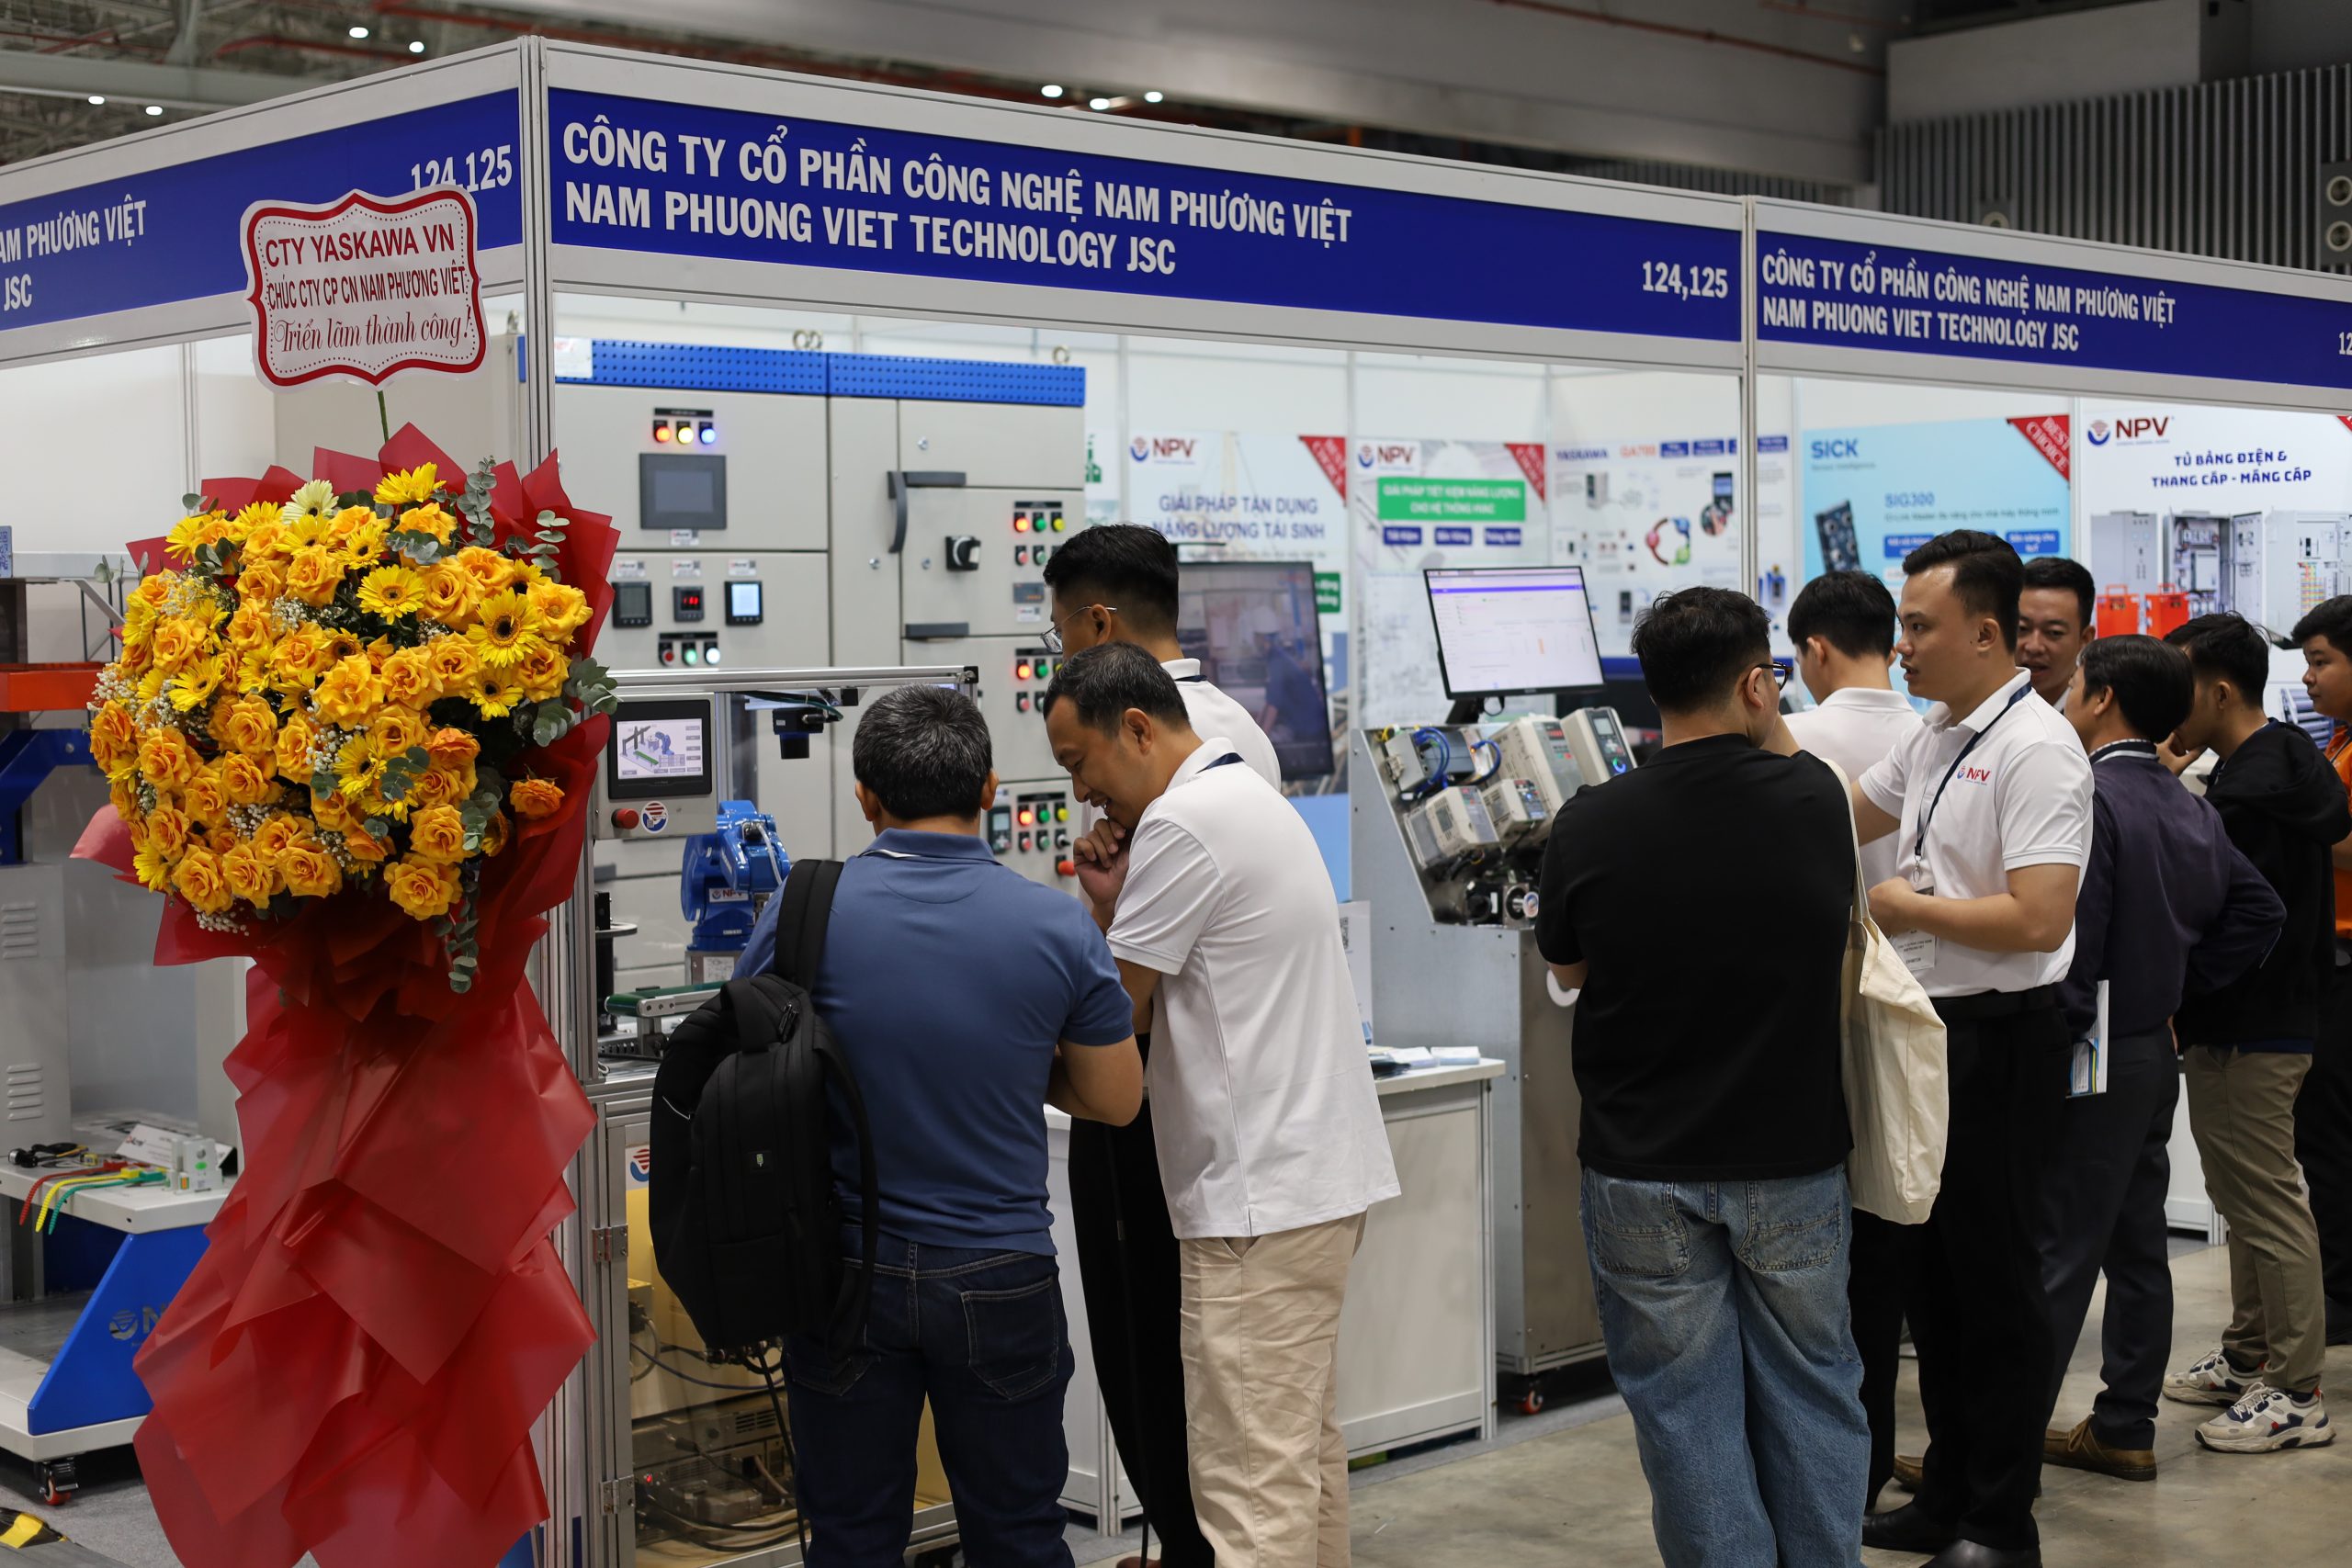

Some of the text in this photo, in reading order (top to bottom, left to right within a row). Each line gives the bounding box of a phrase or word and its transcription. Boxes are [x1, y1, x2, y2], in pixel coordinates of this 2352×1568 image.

[411, 144, 513, 192] 124125
[563, 114, 1351, 248] CÔNG TY CỔ PHẦN CÔNG NGHỆ NAM PHƯƠNG VIỆT
[27, 210, 99, 258] PHƯƠNG
[104, 194, 146, 246] VIỆT
[266, 223, 455, 267] CTY YASKAWA VN
[566, 181, 1176, 275] NAM PHUONG VIET TECHNOLOGY JSC
[4, 274, 32, 311] JSC
[268, 274, 297, 310] CHÚC
[300, 279, 320, 308] CTY
[323, 277, 338, 305] CP
[341, 276, 358, 303] CN
[360, 273, 386, 302] NAM
[386, 268, 438, 299] PHƯƠNG
[1643, 261, 1728, 300] 124,125
[1762, 248, 2176, 328] CÔNG TY CỔ PHẦN CÔNG NGHỆ NAM PHƯƠNG VIỆT
[276, 317, 322, 352] Triển
[327, 319, 361, 348] lãm
[366, 311, 416, 346] thành
[1763, 296, 2079, 351] NAM PHUONG VIET TECHNOLOGY JSC
[2116, 416, 2169, 438] NPV
[1153, 438, 1195, 457] NPV
[1378, 446, 1413, 463] NPV
[1811, 437, 1859, 459] SICK
[2174, 448, 2287, 467] TỦ BẢNG ĐIỆN &
[2152, 475, 2198, 487] THANG
[1291, 523, 1325, 539] SINH
